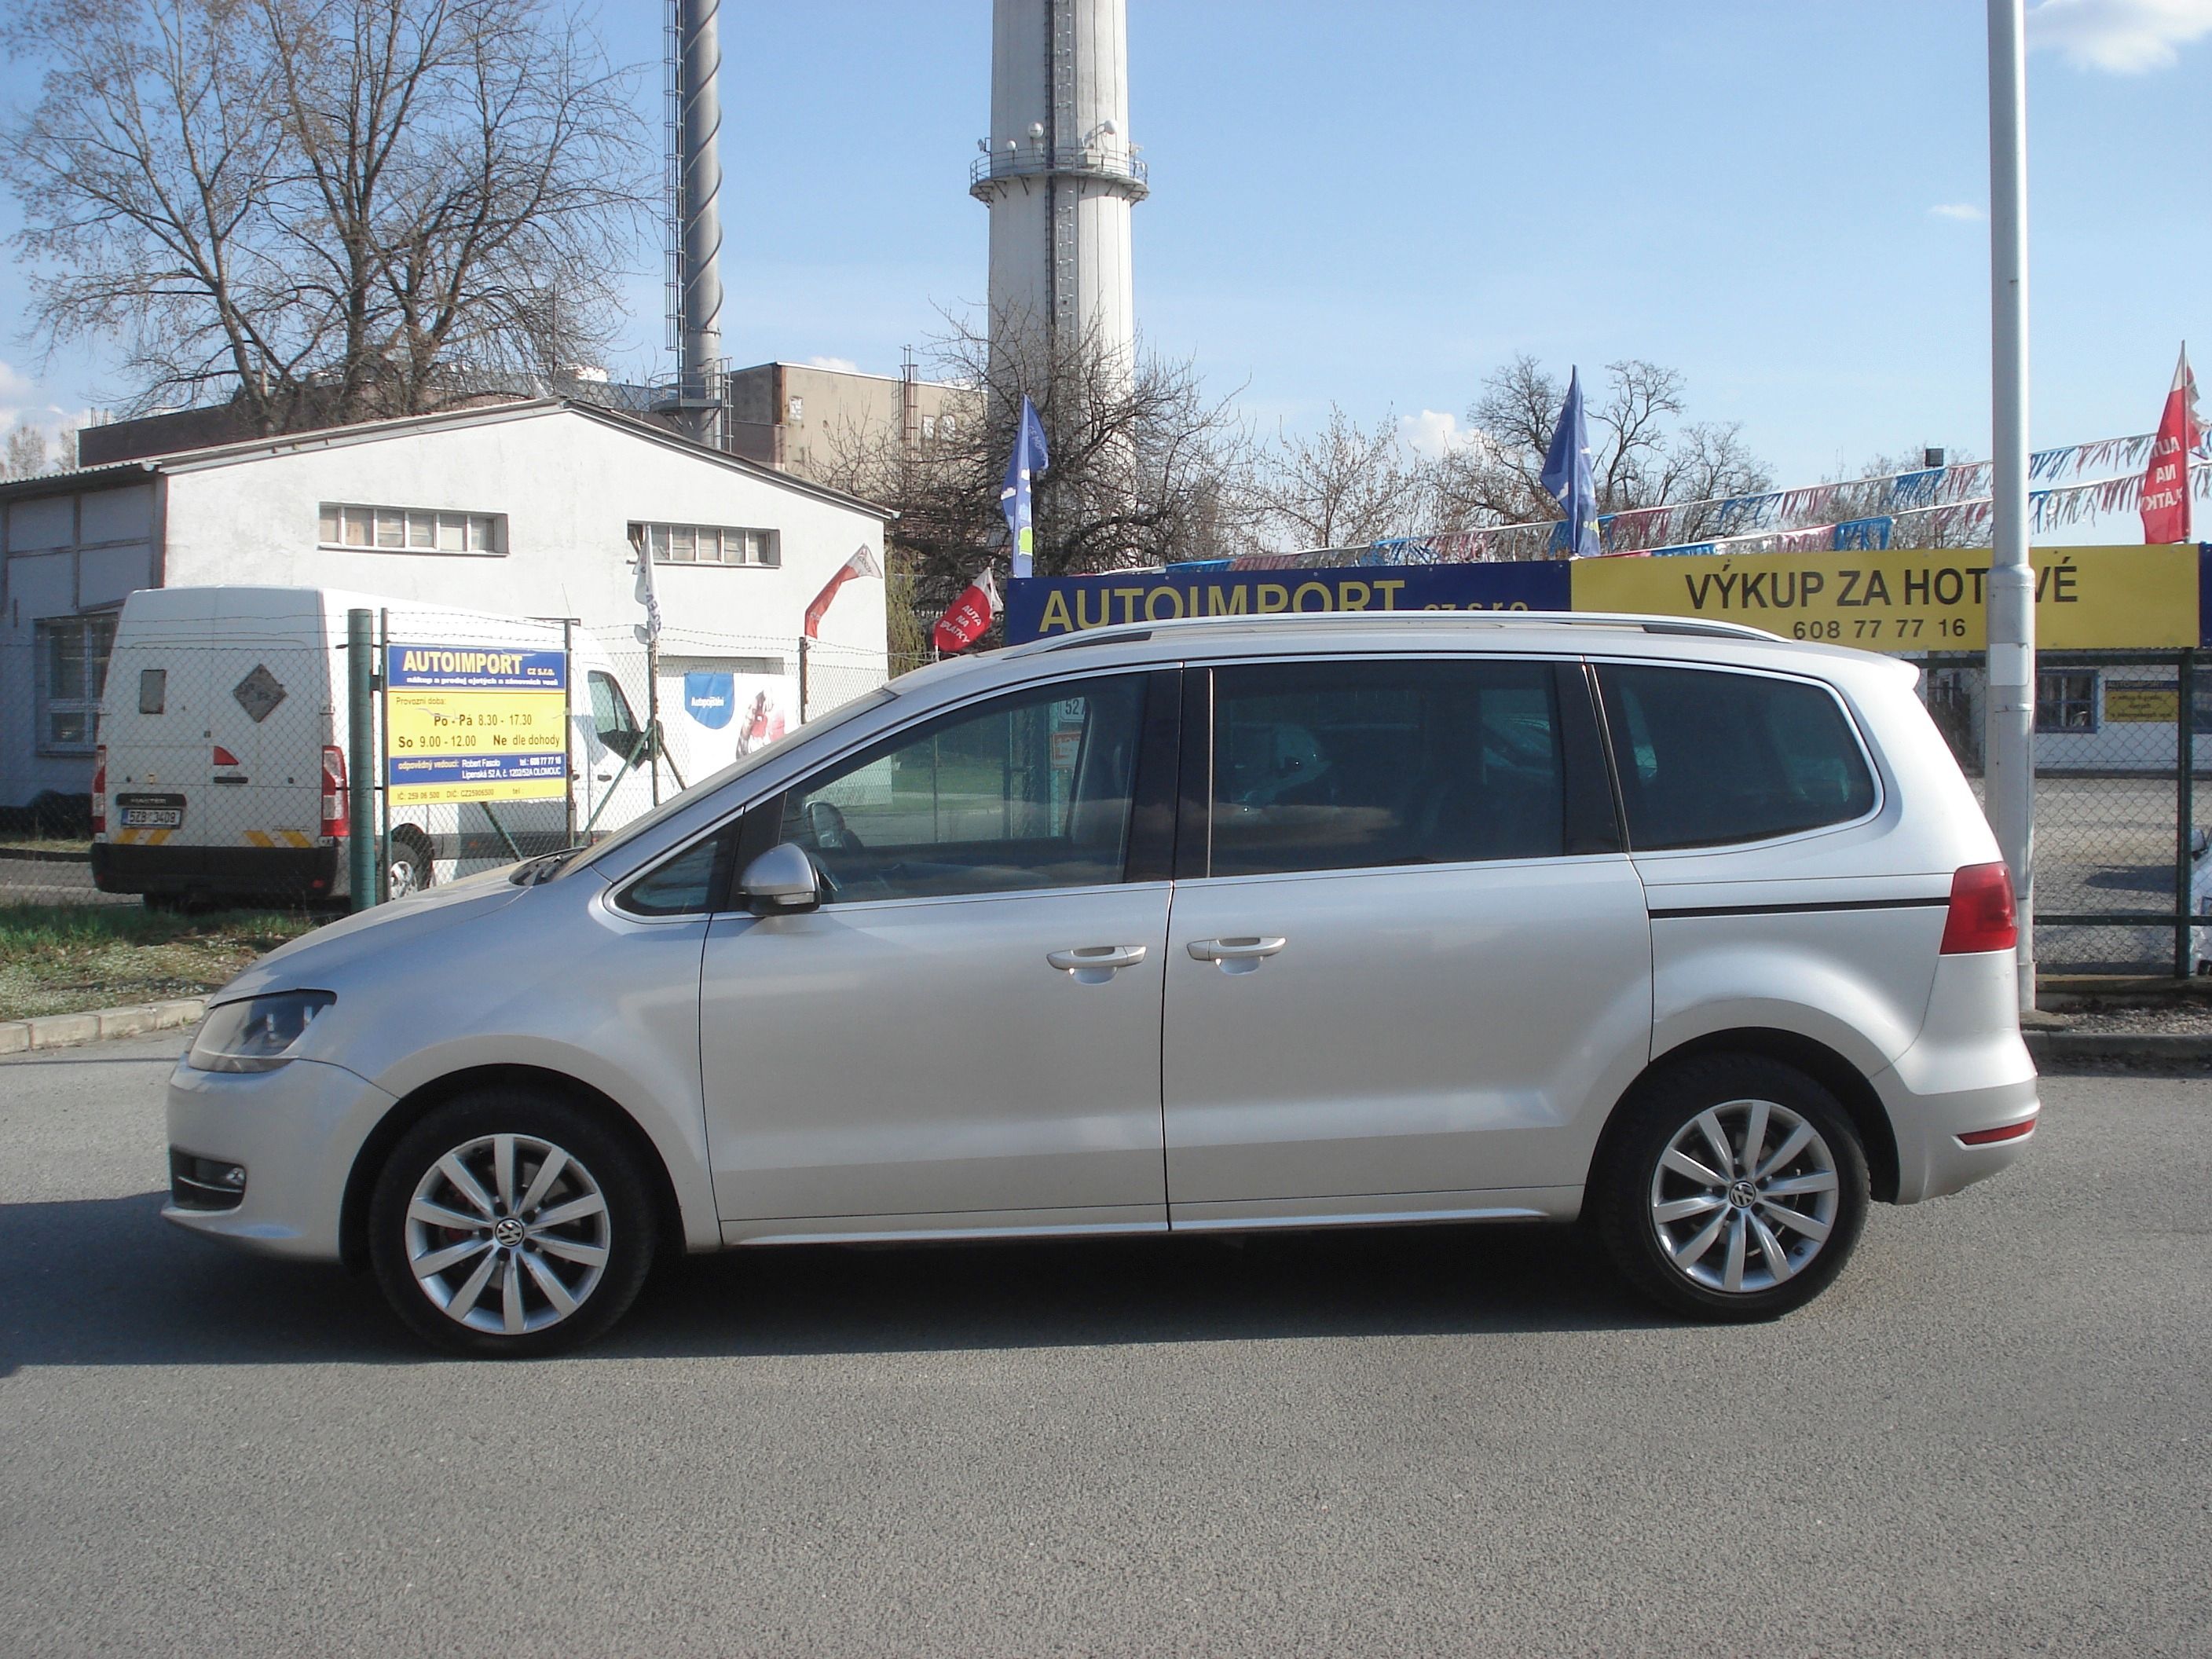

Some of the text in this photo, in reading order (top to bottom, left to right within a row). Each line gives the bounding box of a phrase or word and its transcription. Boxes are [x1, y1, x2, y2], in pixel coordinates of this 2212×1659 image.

[1685, 556, 2078, 610] VÝKUP ZA HOTVÉ
[961, 605, 982, 626] AUTA
[1038, 580, 1405, 633] AUTOIMPORT
[955, 615, 969, 627] NA
[1793, 618, 1966, 639] 608 77 77 16
[403, 650, 523, 675] AUTOIMPORT
[396, 697, 446, 705] Provozní doba:
[1065, 698, 1085, 716] 52
[434, 715, 448, 727] Po
[460, 714, 472, 727] Pá
[478, 714, 498, 726] 8.30
[510, 713, 533, 726] 17.30
[398, 736, 413, 748] So
[419, 735, 441, 747] 9.00
[451, 734, 476, 747] 12.00
[493, 734, 507, 745] Ne
[513, 734, 527, 745] dle
[529, 734, 560, 747] dohody
[130, 811, 147, 823] 5ZB
